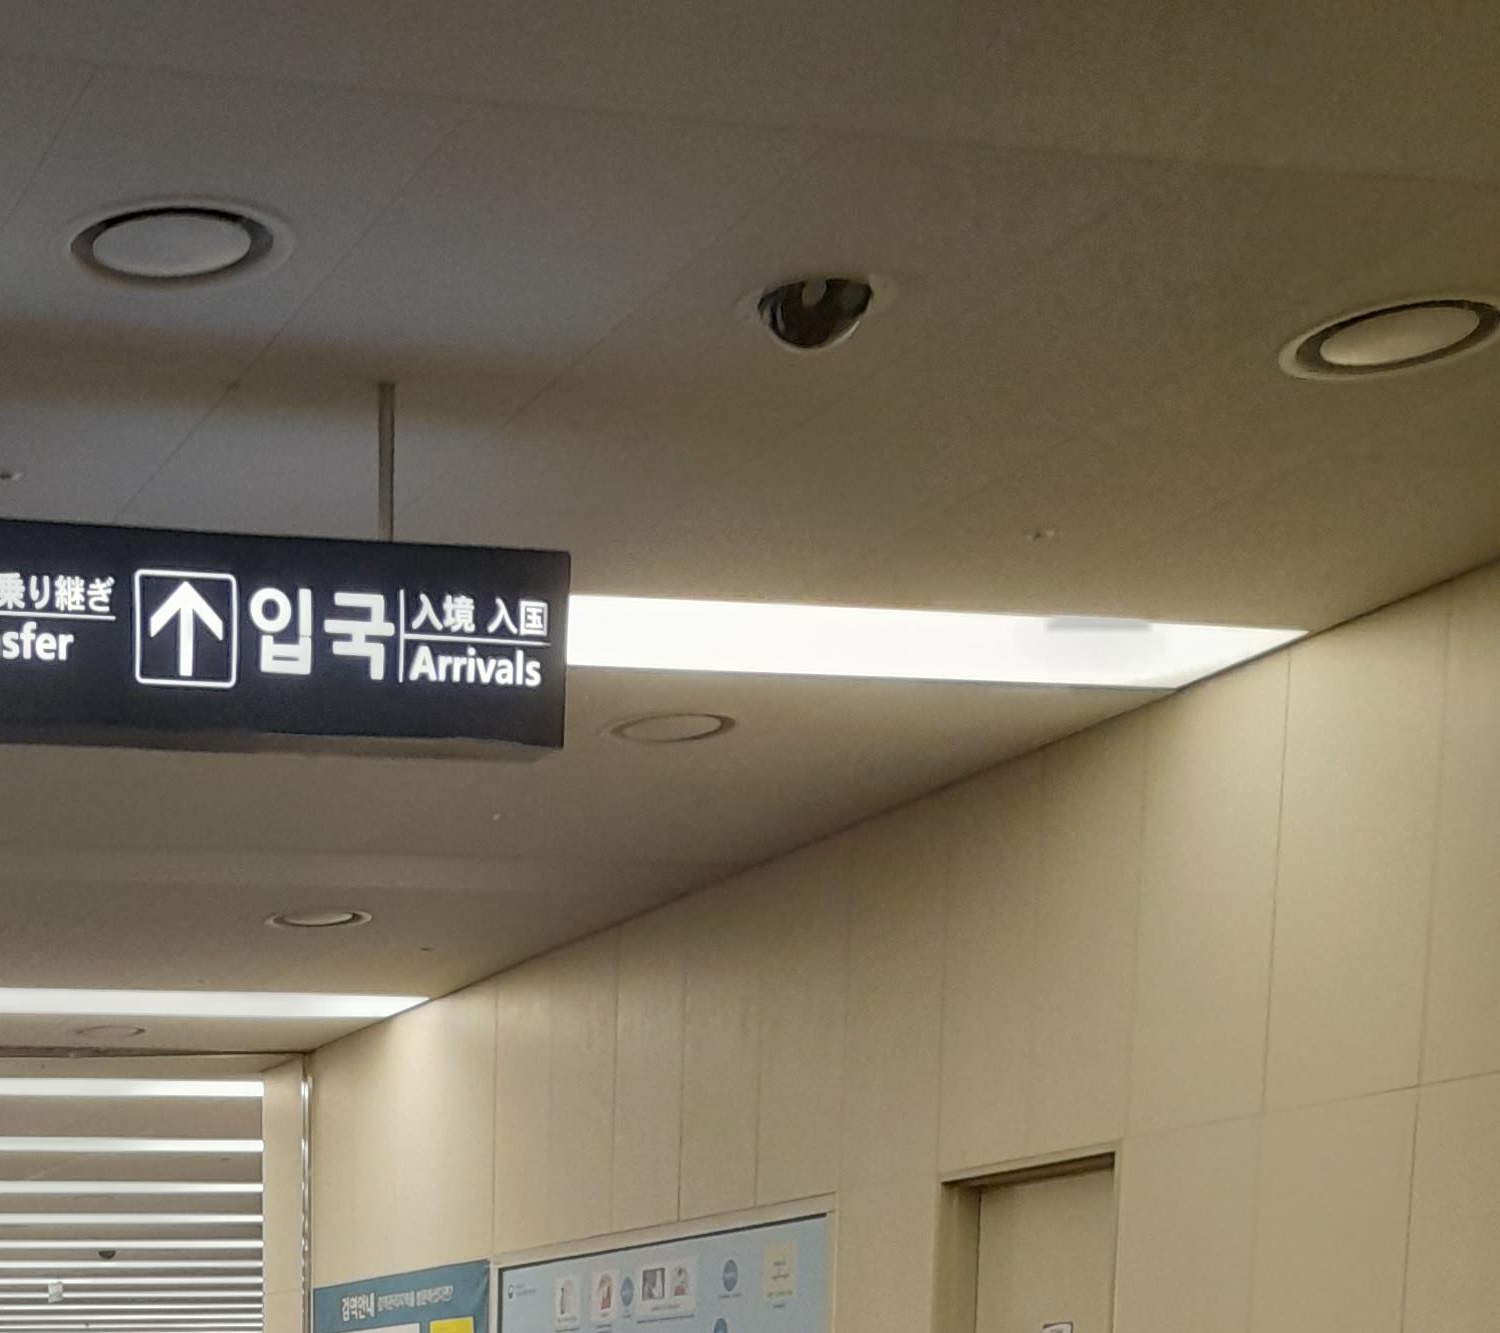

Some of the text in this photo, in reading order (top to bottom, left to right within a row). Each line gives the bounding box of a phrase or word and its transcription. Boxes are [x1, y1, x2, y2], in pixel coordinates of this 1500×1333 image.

[411, 593, 476, 633] 入境
[487, 597, 549, 637] 入国
[250, 587, 395, 681] 입국
[408, 645, 542, 687] Arrivals
